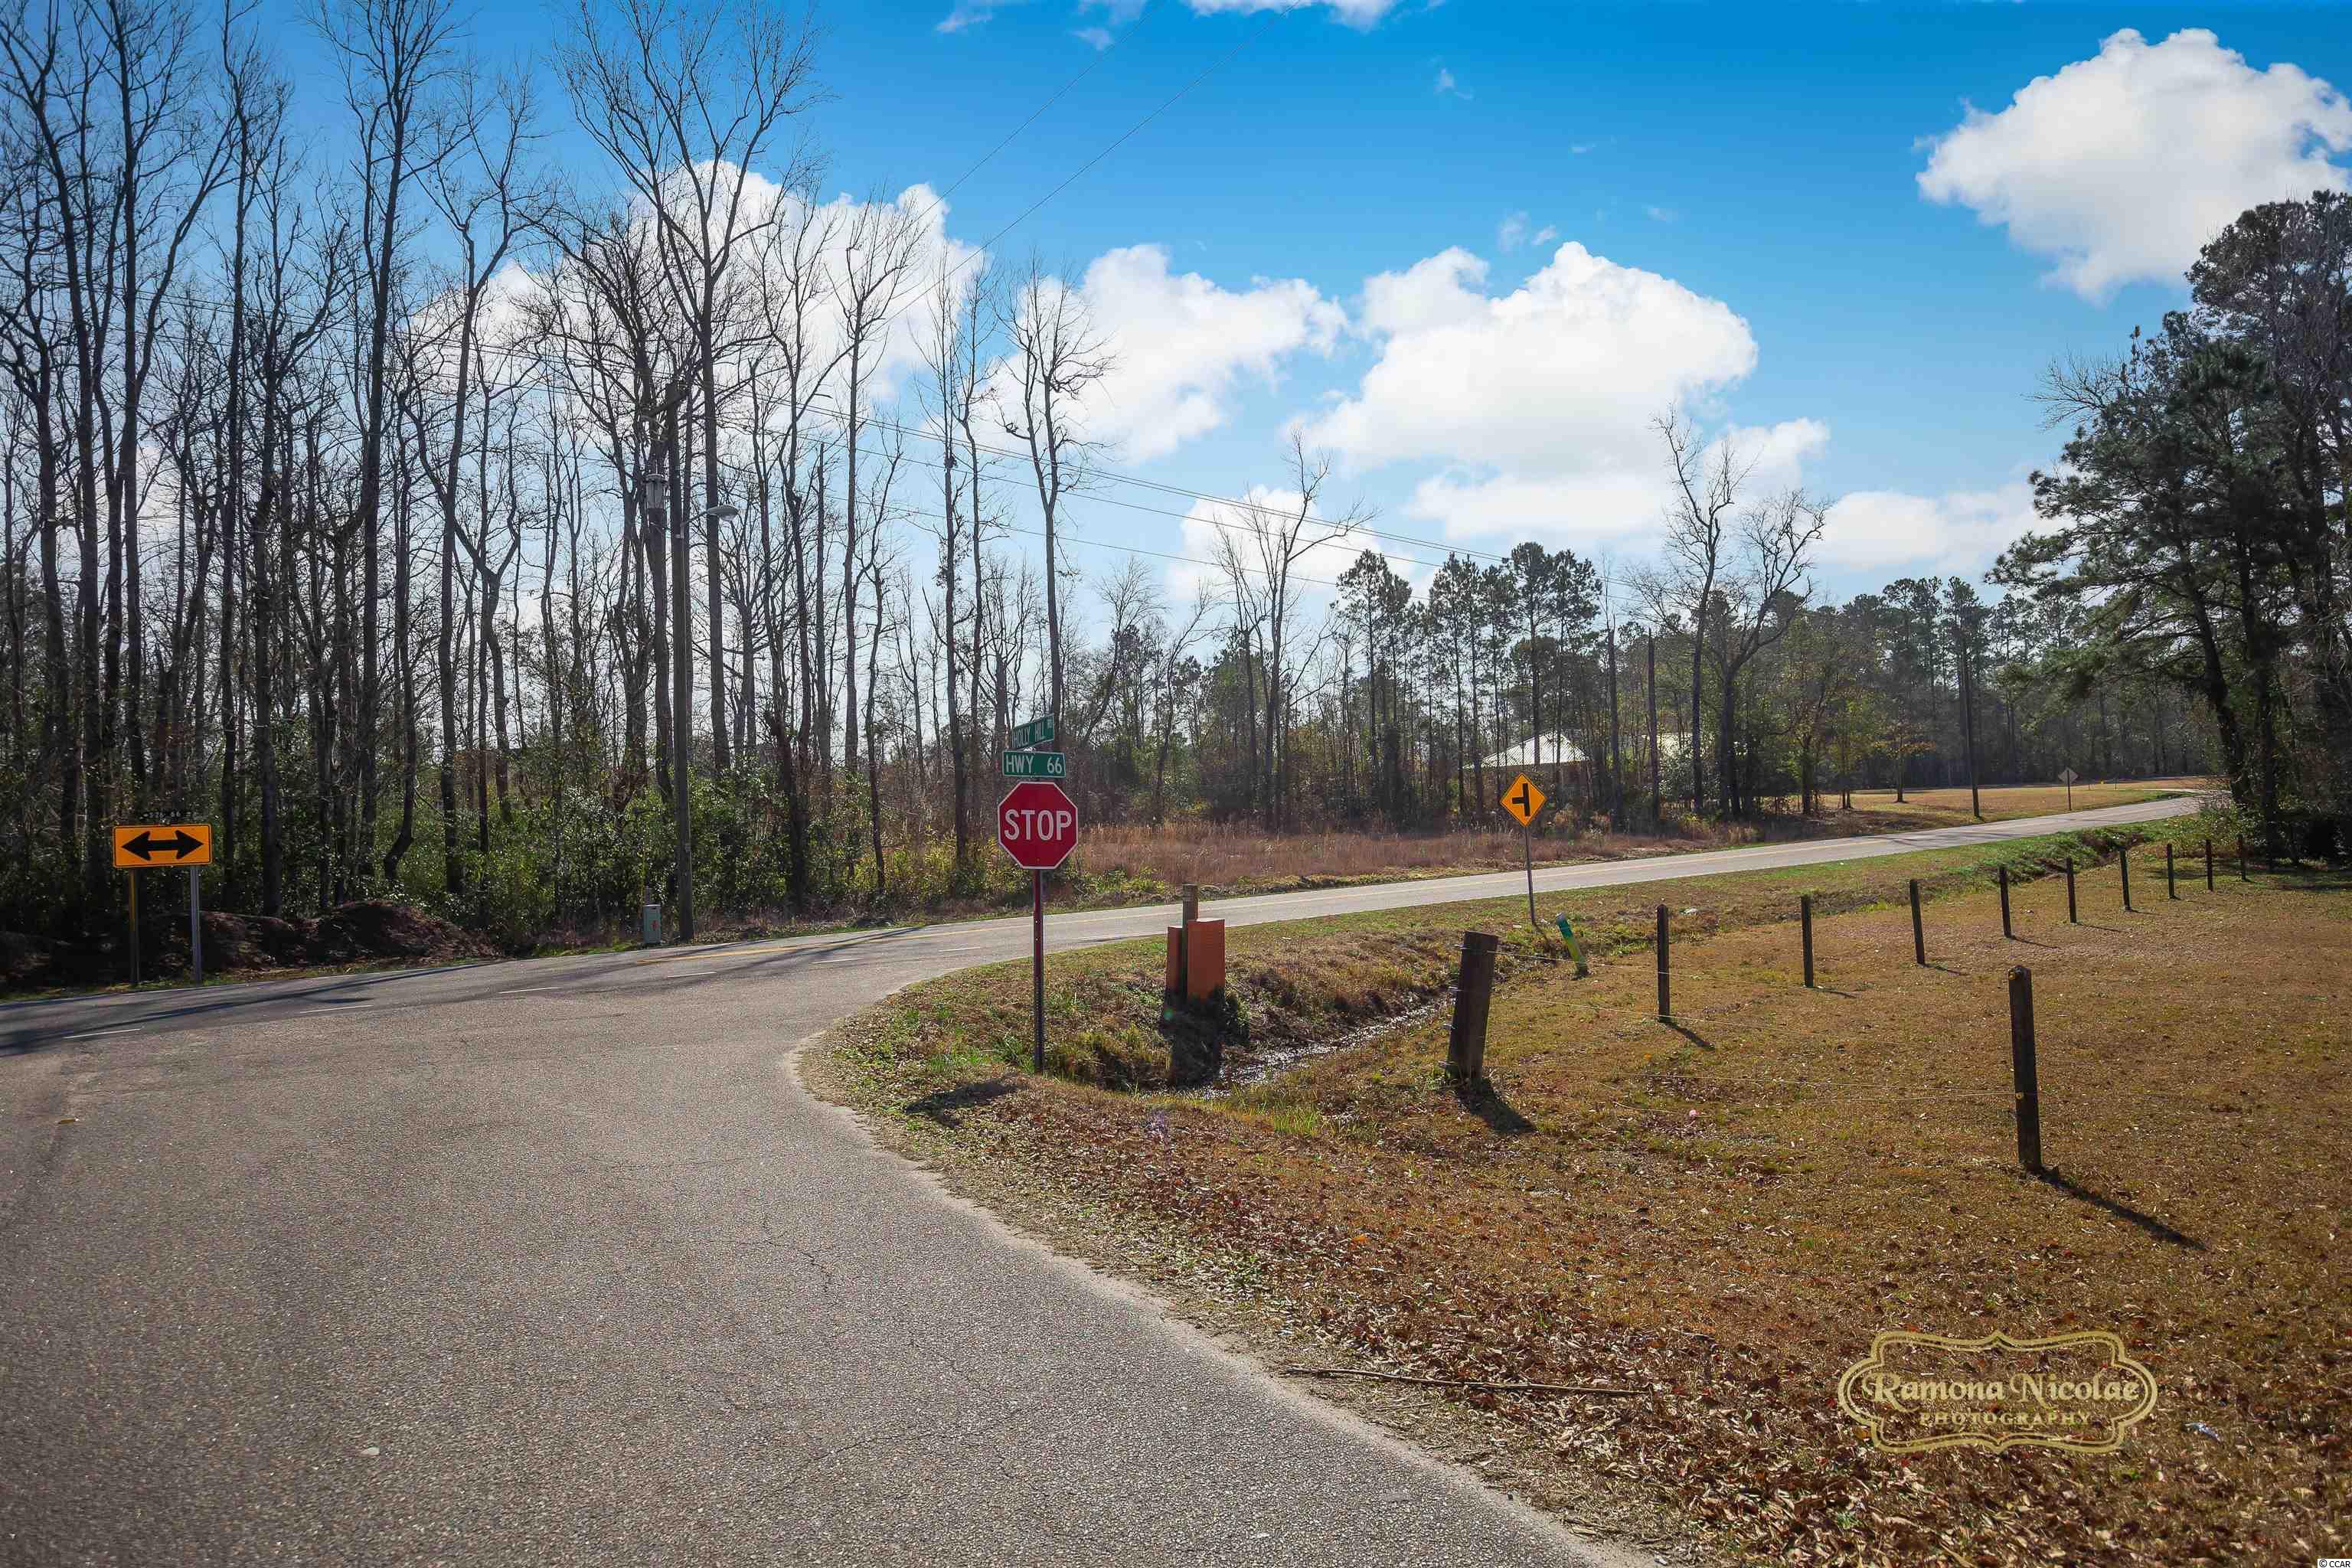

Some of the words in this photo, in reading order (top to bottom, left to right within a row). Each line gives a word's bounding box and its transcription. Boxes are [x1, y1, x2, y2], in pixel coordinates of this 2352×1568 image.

[1012, 726, 1031, 748] HOLLY
[1005, 754, 1034, 773] HWY
[1047, 756, 1062, 773] 66
[1004, 809, 1072, 841] STOP
